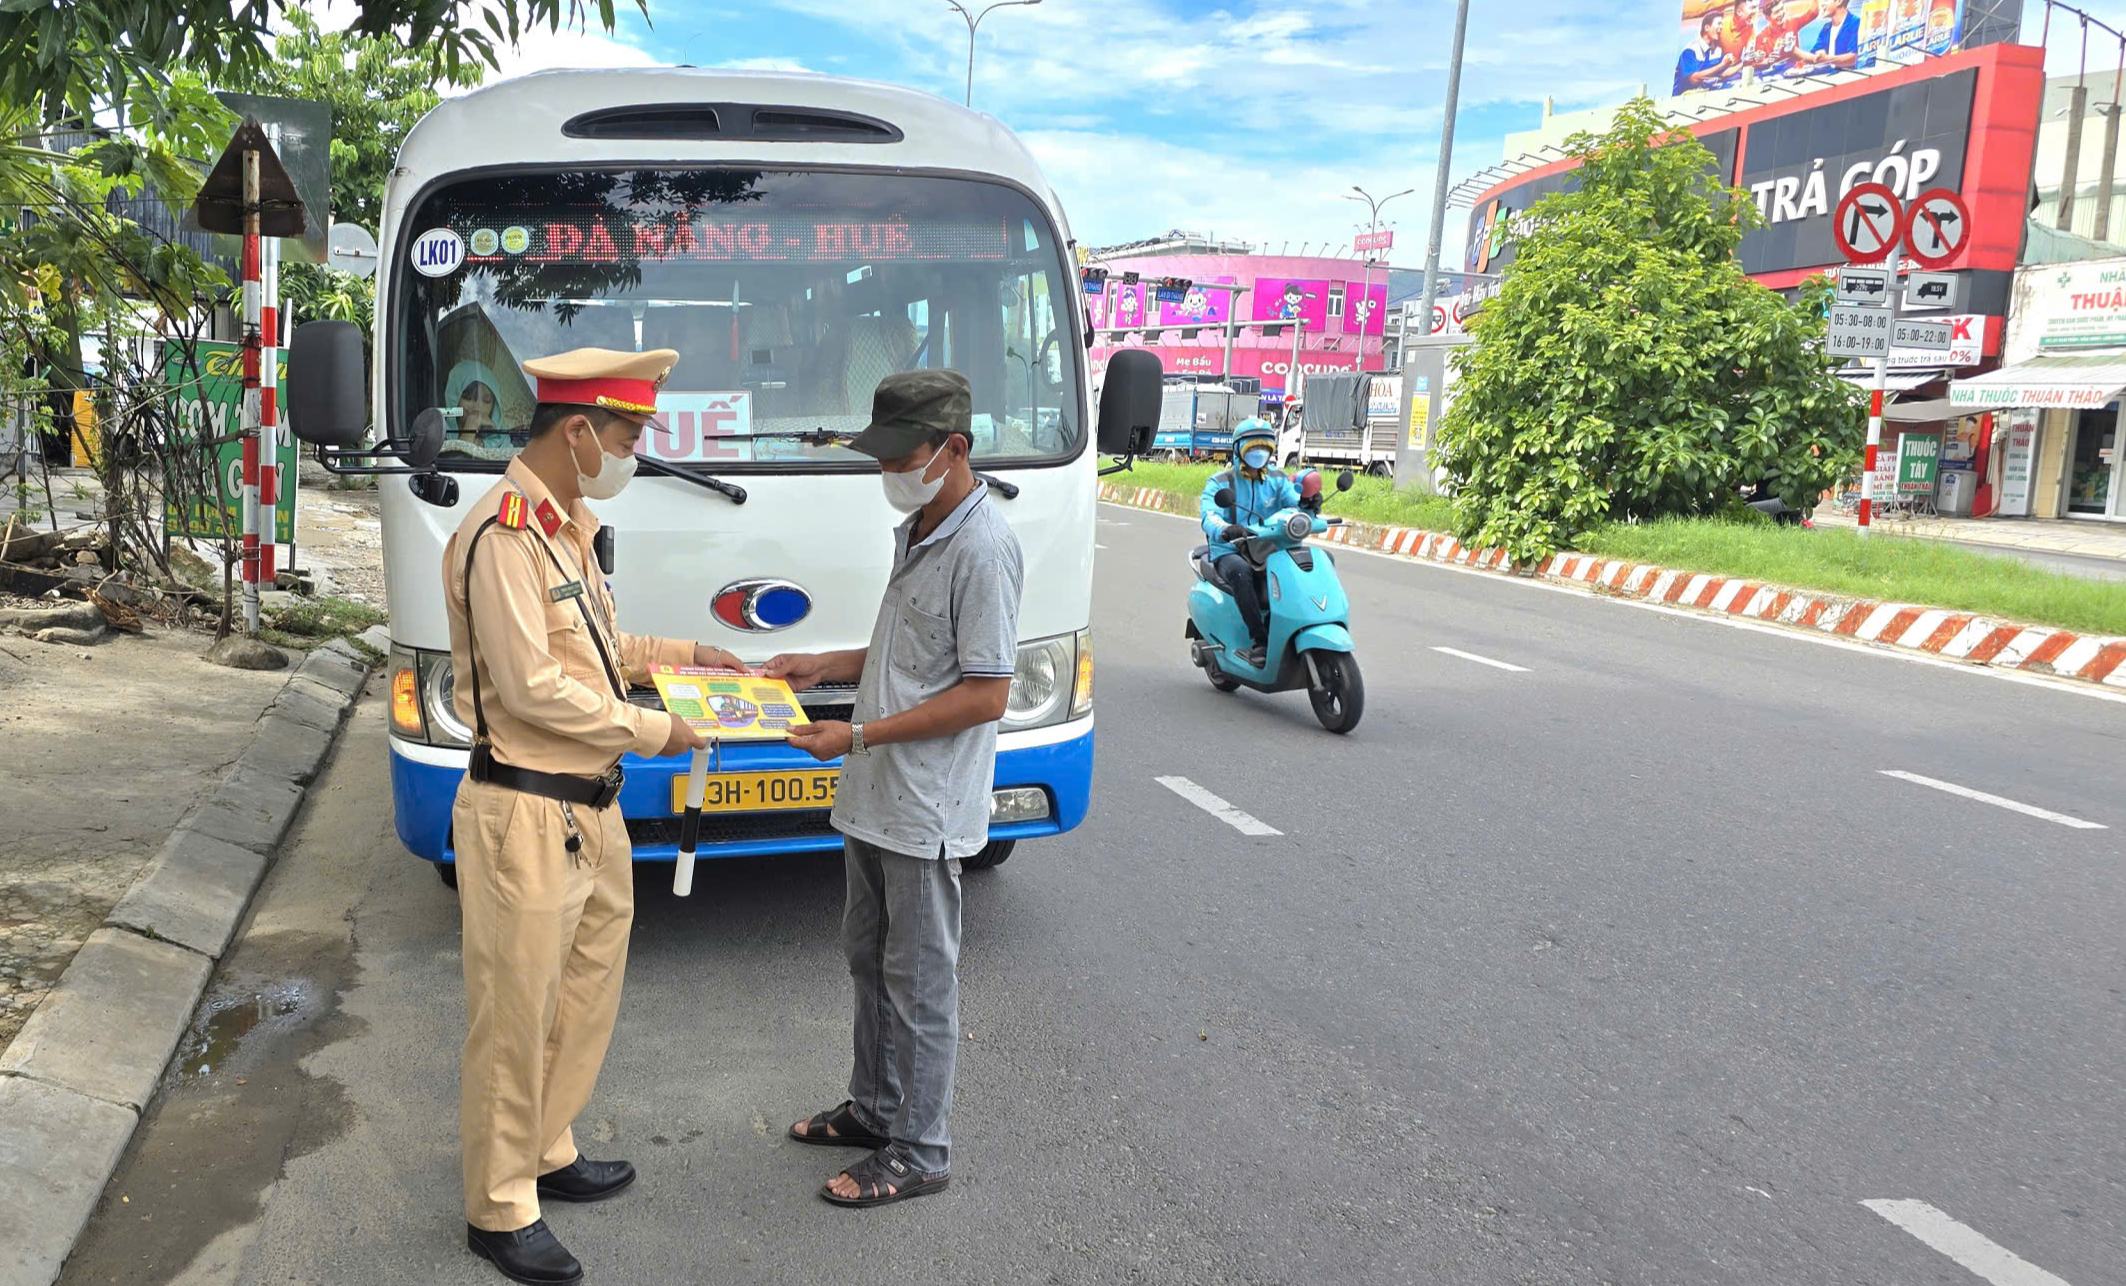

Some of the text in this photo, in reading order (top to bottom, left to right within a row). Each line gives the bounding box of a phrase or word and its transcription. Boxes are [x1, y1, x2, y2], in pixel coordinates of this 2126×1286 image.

[1751, 139, 1941, 223] TRẢ GÓP
[419, 239, 456, 266] LK01
[2071, 287, 2126, 312] THUẬ
[1834, 313, 1887, 329] 05:30-08:00
[1832, 335, 1885, 351] 16:00-19:00
[1897, 328, 1947, 344] 05:00-22:00
[1905, 436, 1937, 457] THUỐC
[1910, 460, 1928, 479] TÂY
[703, 777, 839, 804] 3H-100.5
